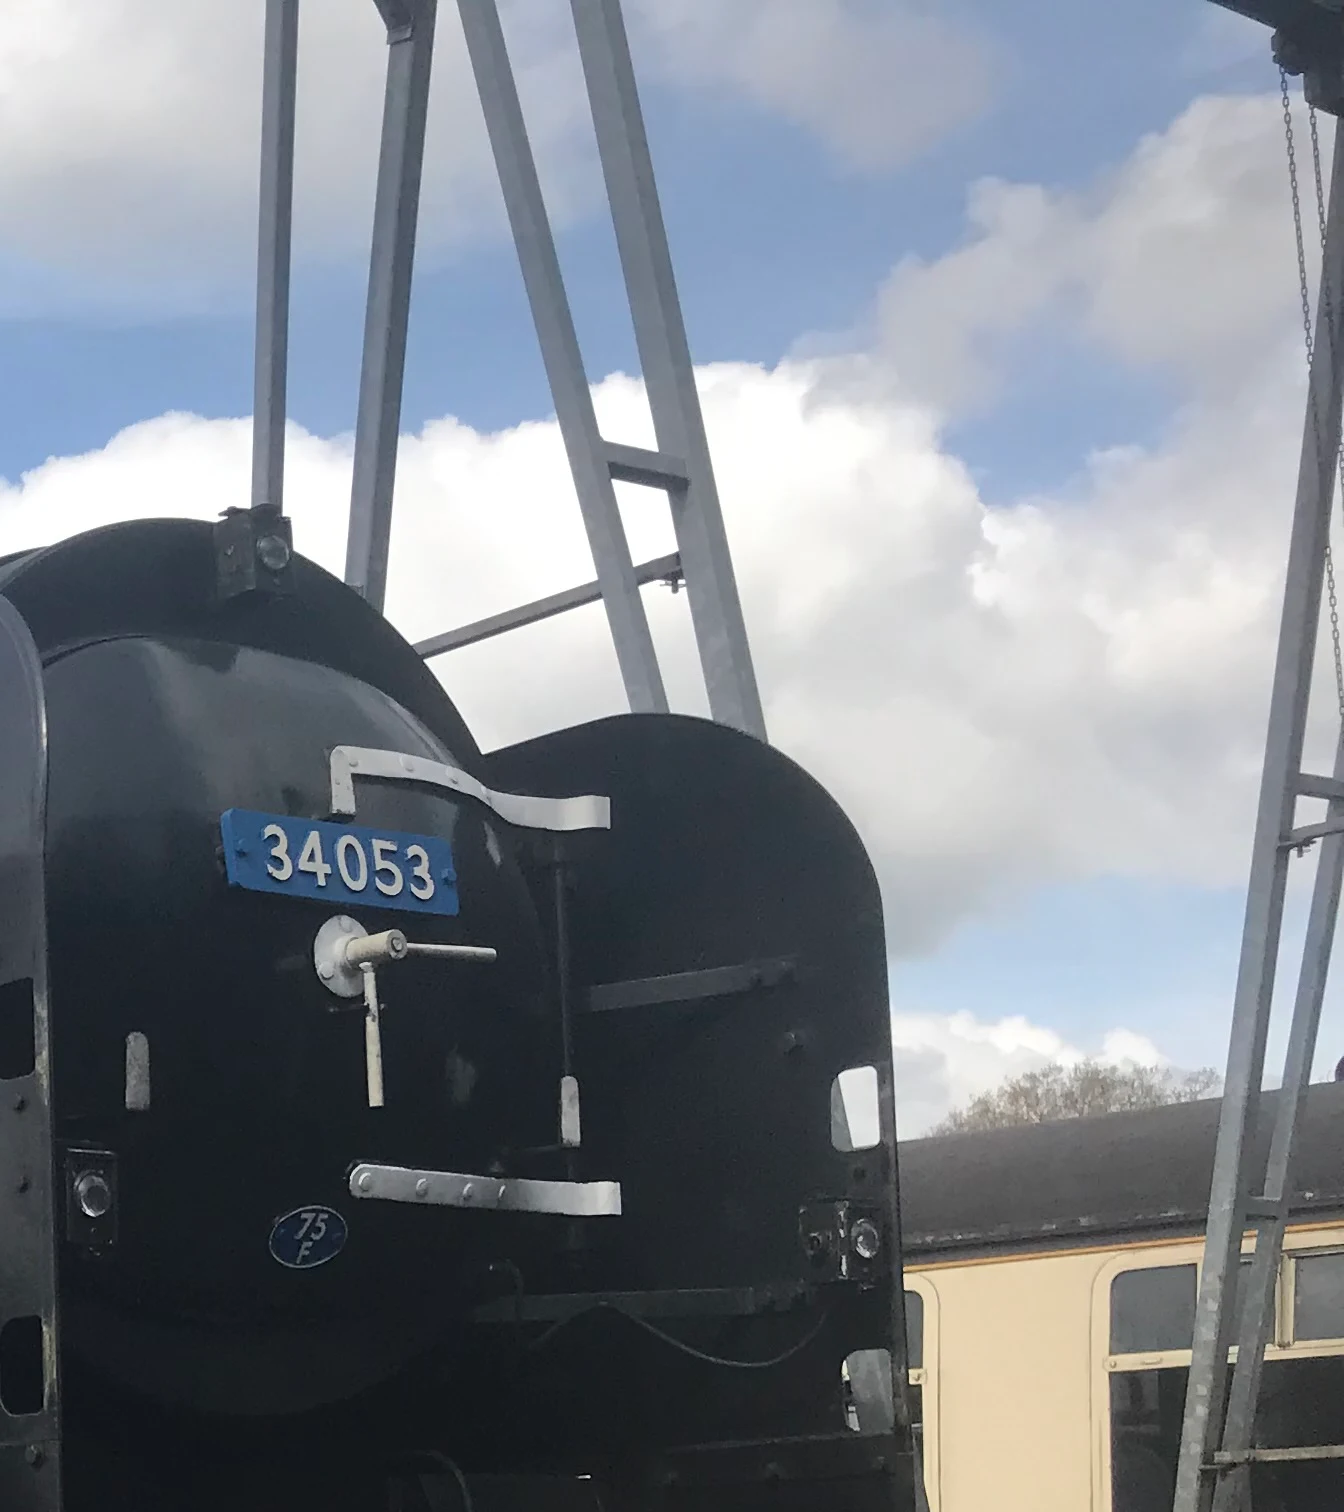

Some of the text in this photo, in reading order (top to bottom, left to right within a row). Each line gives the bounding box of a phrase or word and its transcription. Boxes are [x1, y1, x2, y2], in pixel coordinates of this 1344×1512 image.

[263, 824, 435, 900] 34053
[293, 1212, 329, 1240] 75
[296, 1241, 313, 1264] F
